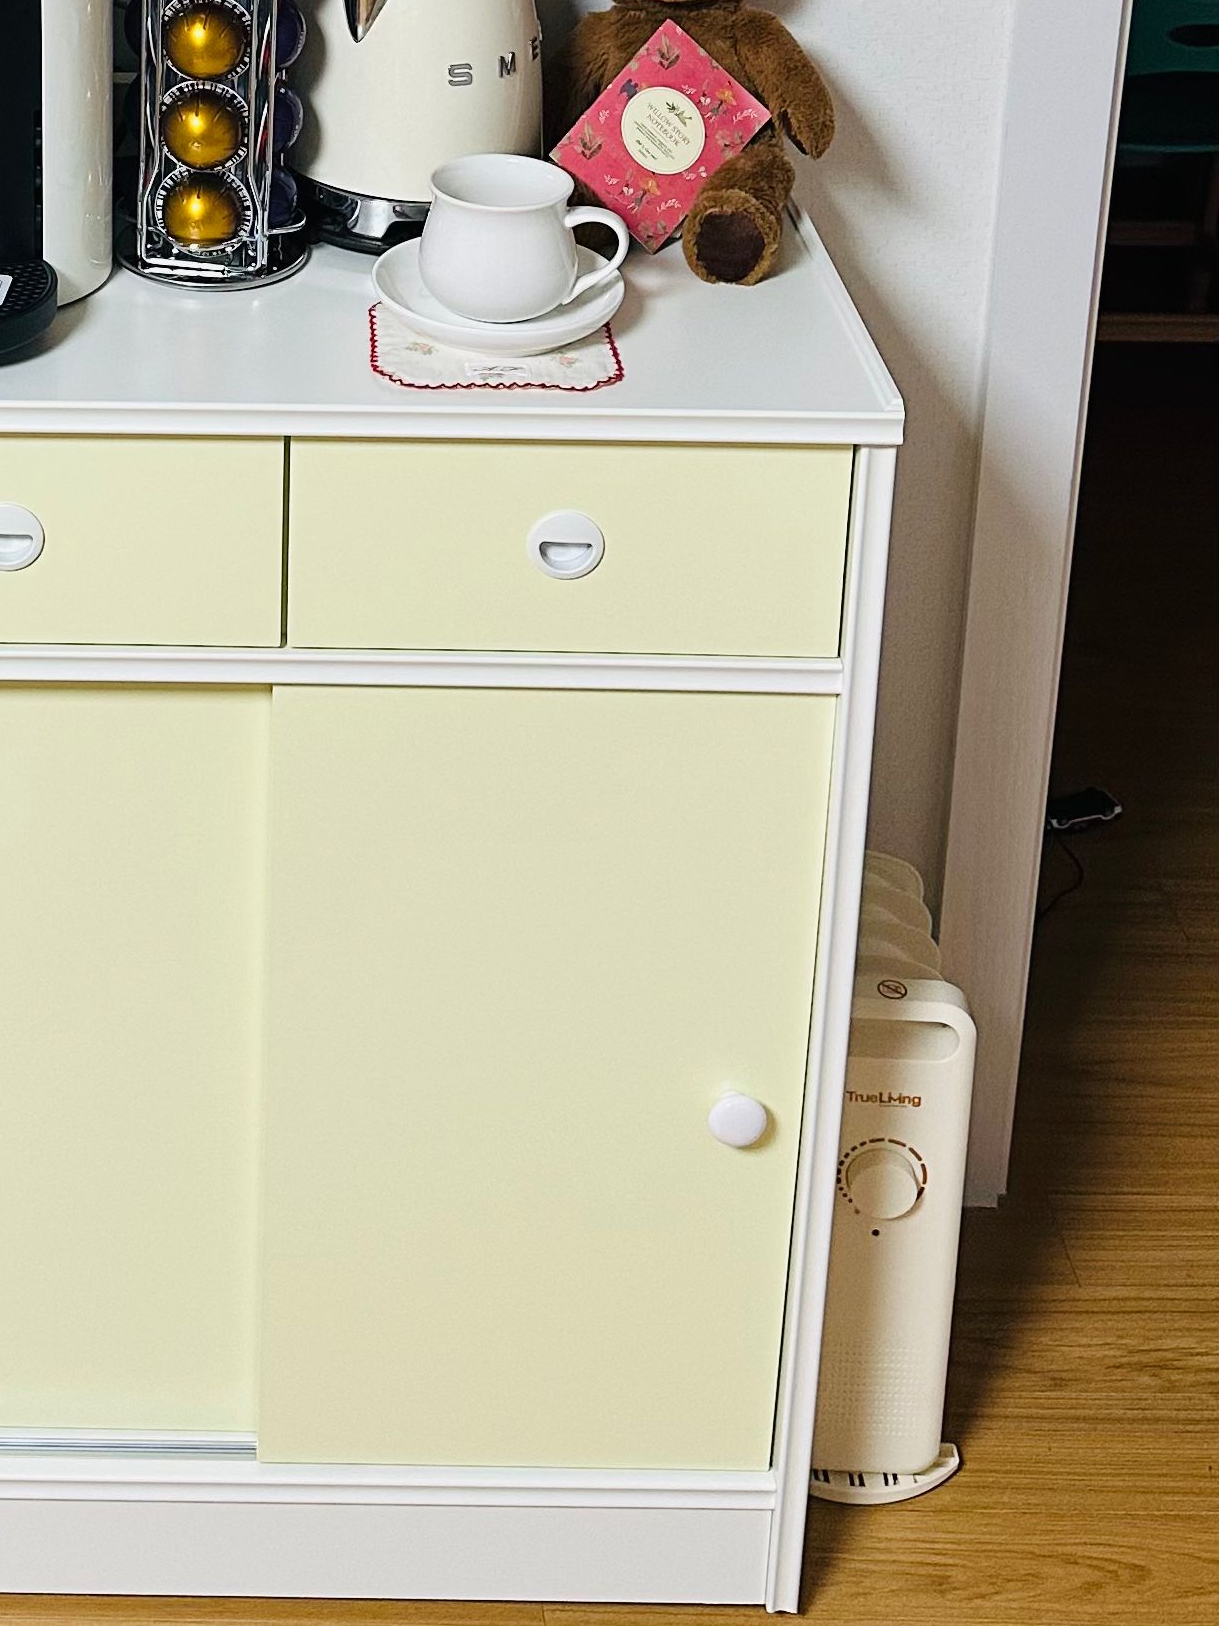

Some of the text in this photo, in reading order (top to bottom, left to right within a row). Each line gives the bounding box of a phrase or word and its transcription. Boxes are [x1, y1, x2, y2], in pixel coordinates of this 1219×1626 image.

[647, 102, 672, 130] WILLOW
[671, 126, 691, 146] STORY
[647, 114, 680, 147] NOTEBOOK
